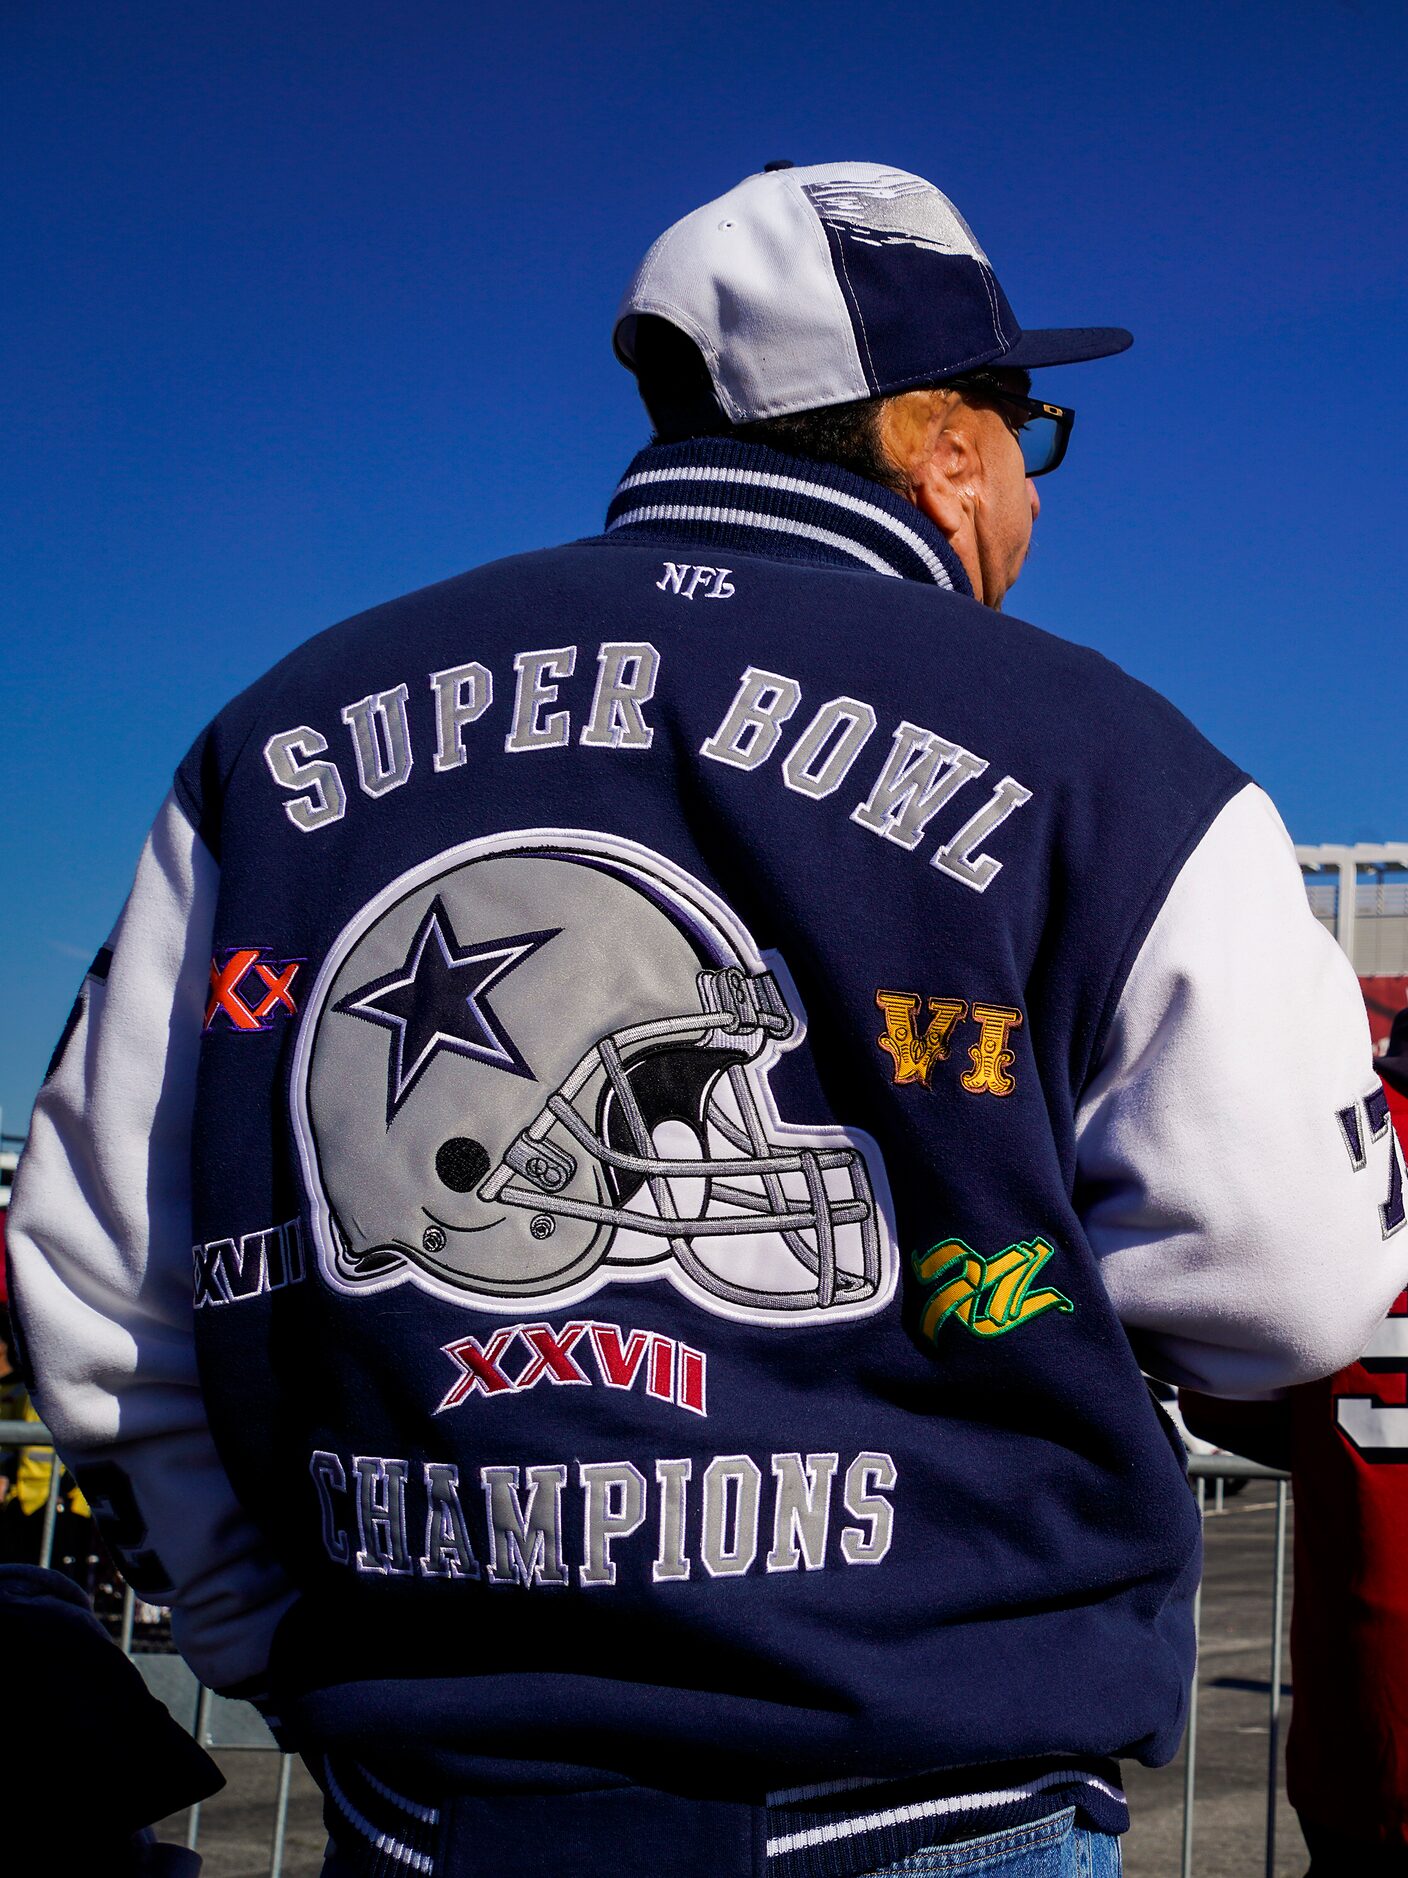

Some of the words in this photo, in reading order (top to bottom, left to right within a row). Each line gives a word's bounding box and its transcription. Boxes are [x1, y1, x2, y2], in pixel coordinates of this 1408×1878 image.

[656, 562, 735, 600] NFL
[263, 642, 661, 833] SUPER
[699, 665, 1034, 892] BOWL
[876, 989, 1024, 1097] VI
[431, 1320, 708, 1418] XXVII
[308, 1449, 898, 1589] CHAMPIONS
